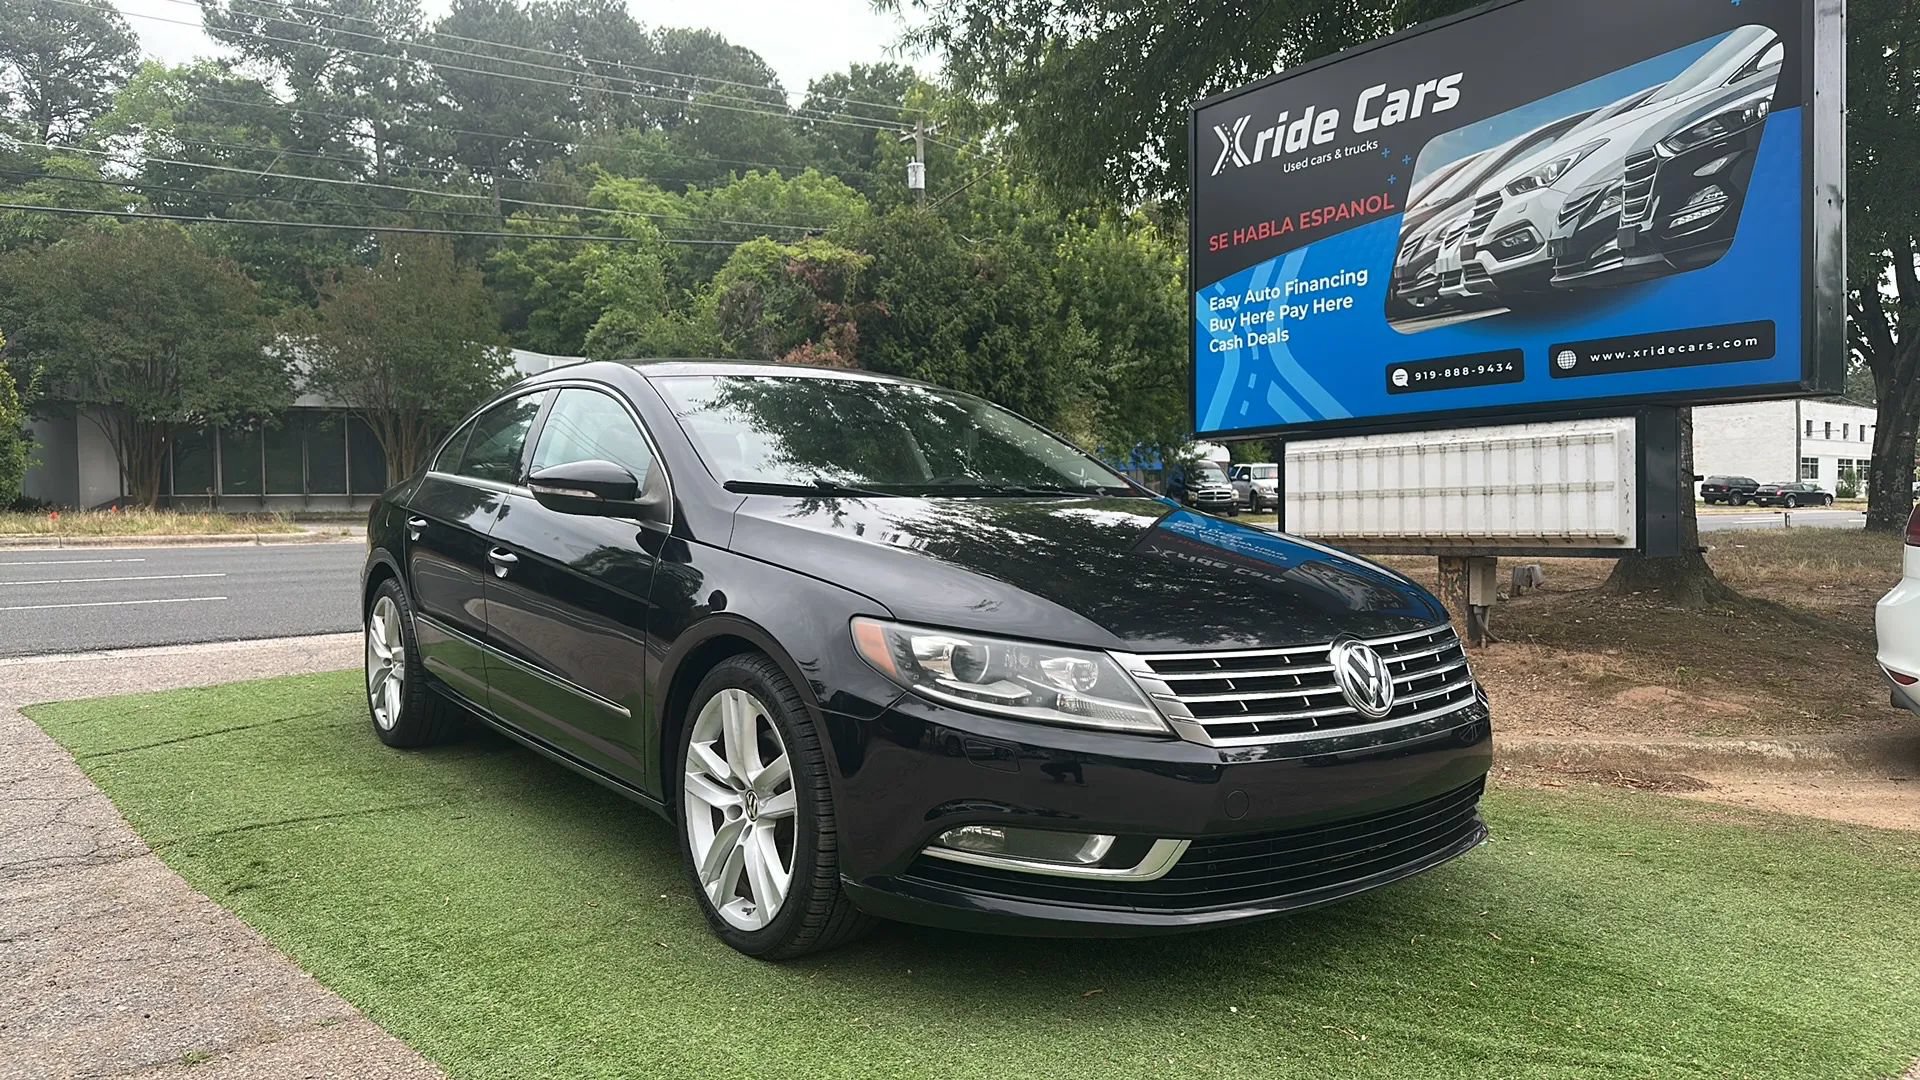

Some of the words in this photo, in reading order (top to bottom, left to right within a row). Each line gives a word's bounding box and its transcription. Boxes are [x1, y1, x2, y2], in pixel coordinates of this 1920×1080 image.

[1352, 72, 1464, 134] Cars
[1283, 157, 1308, 173] Used
[1310, 153, 1332, 166] cars
[1334, 149, 1342, 160] &
[1344, 139, 1379, 157] trucks
[1209, 232, 1229, 251] SE
[1233, 216, 1294, 245] HABLA
[1299, 192, 1395, 230] ESPANOL
[1209, 294, 1241, 312] Easy
[1244, 286, 1281, 304] Auto
[1285, 269, 1368, 297] Financing
[1209, 317, 1236, 332] Buy
[1240, 310, 1275, 326] Here
[1279, 303, 1309, 320] Pay
[1313, 296, 1354, 314] Here
[1209, 335, 1243, 353] Cash
[1247, 327, 1290, 347] Deals
[1590, 335, 1759, 362] www.xridecars.com
[1414, 361, 1514, 381] 919-888-9434
